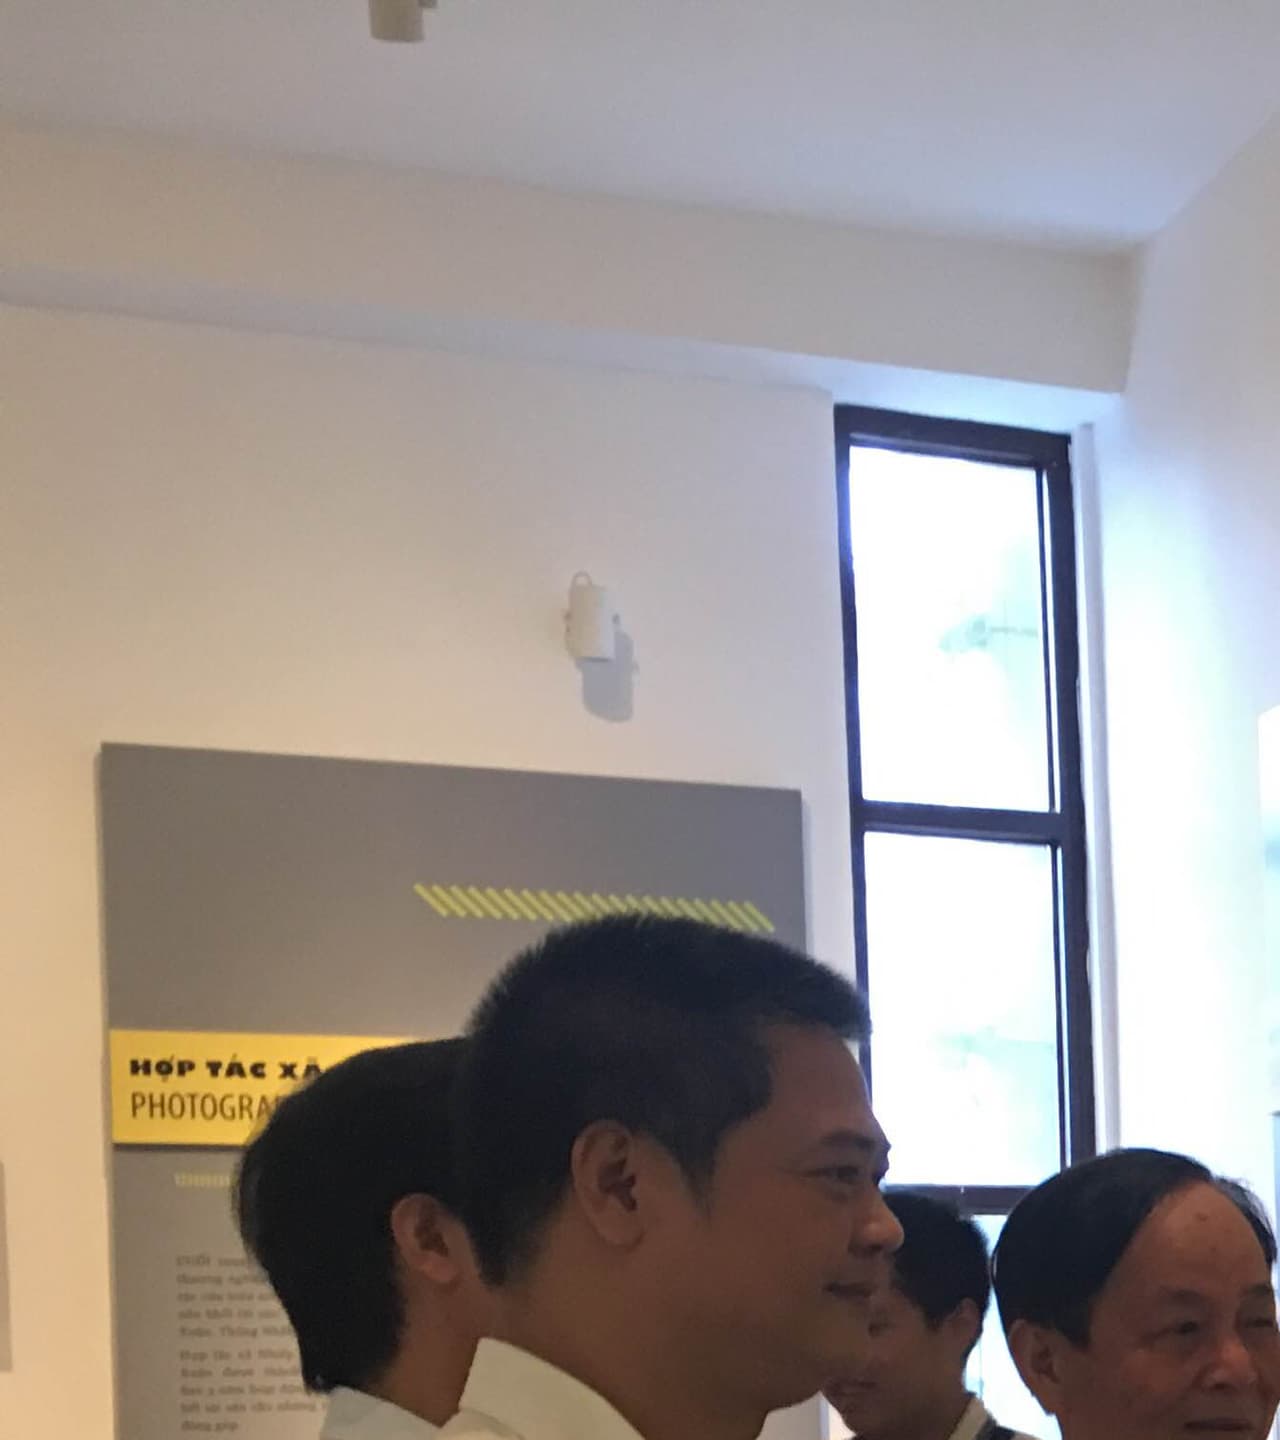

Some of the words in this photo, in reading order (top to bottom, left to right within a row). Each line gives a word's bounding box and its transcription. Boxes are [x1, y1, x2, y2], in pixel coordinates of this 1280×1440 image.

[130, 1055, 196, 1083] HỢP
[205, 1054, 267, 1080] TÁC
[131, 1091, 284, 1121] PHOTOGRA
